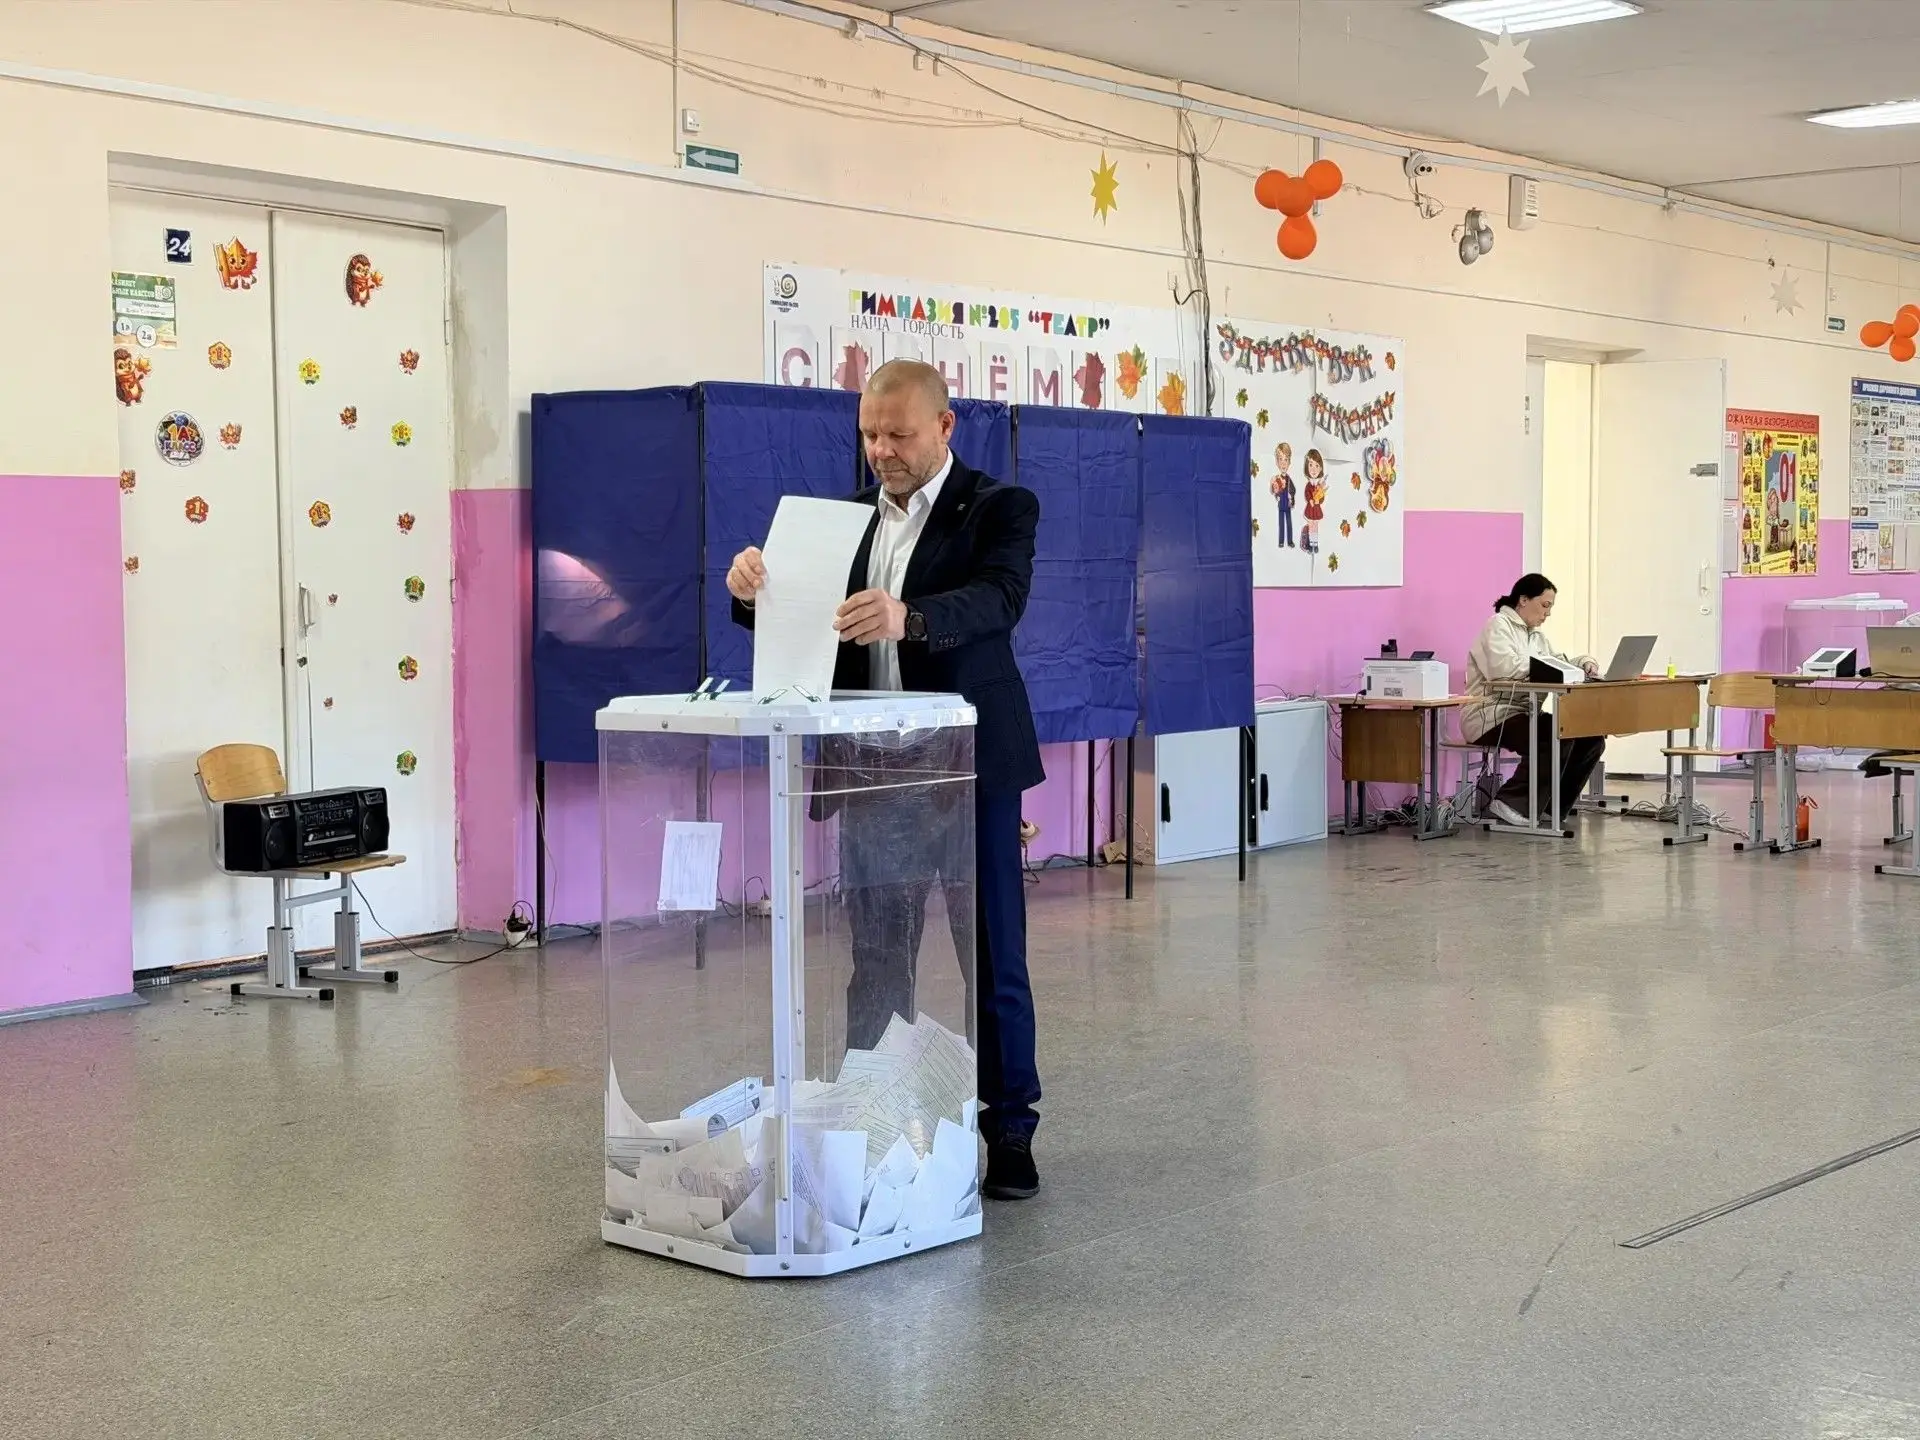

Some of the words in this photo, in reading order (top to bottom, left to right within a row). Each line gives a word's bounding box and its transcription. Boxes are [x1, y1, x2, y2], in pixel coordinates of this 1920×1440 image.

[167, 237, 191, 256] 24
[848, 289, 964, 325] ГИМНАЗИЯ
[969, 303, 1019, 332] №205
[851, 314, 890, 331] НАША
[903, 319, 965, 340] ГОРДОСТЬ
[1727, 413, 1762, 426] ОЖАРНАЯ
[1780, 453, 1796, 503] 01
